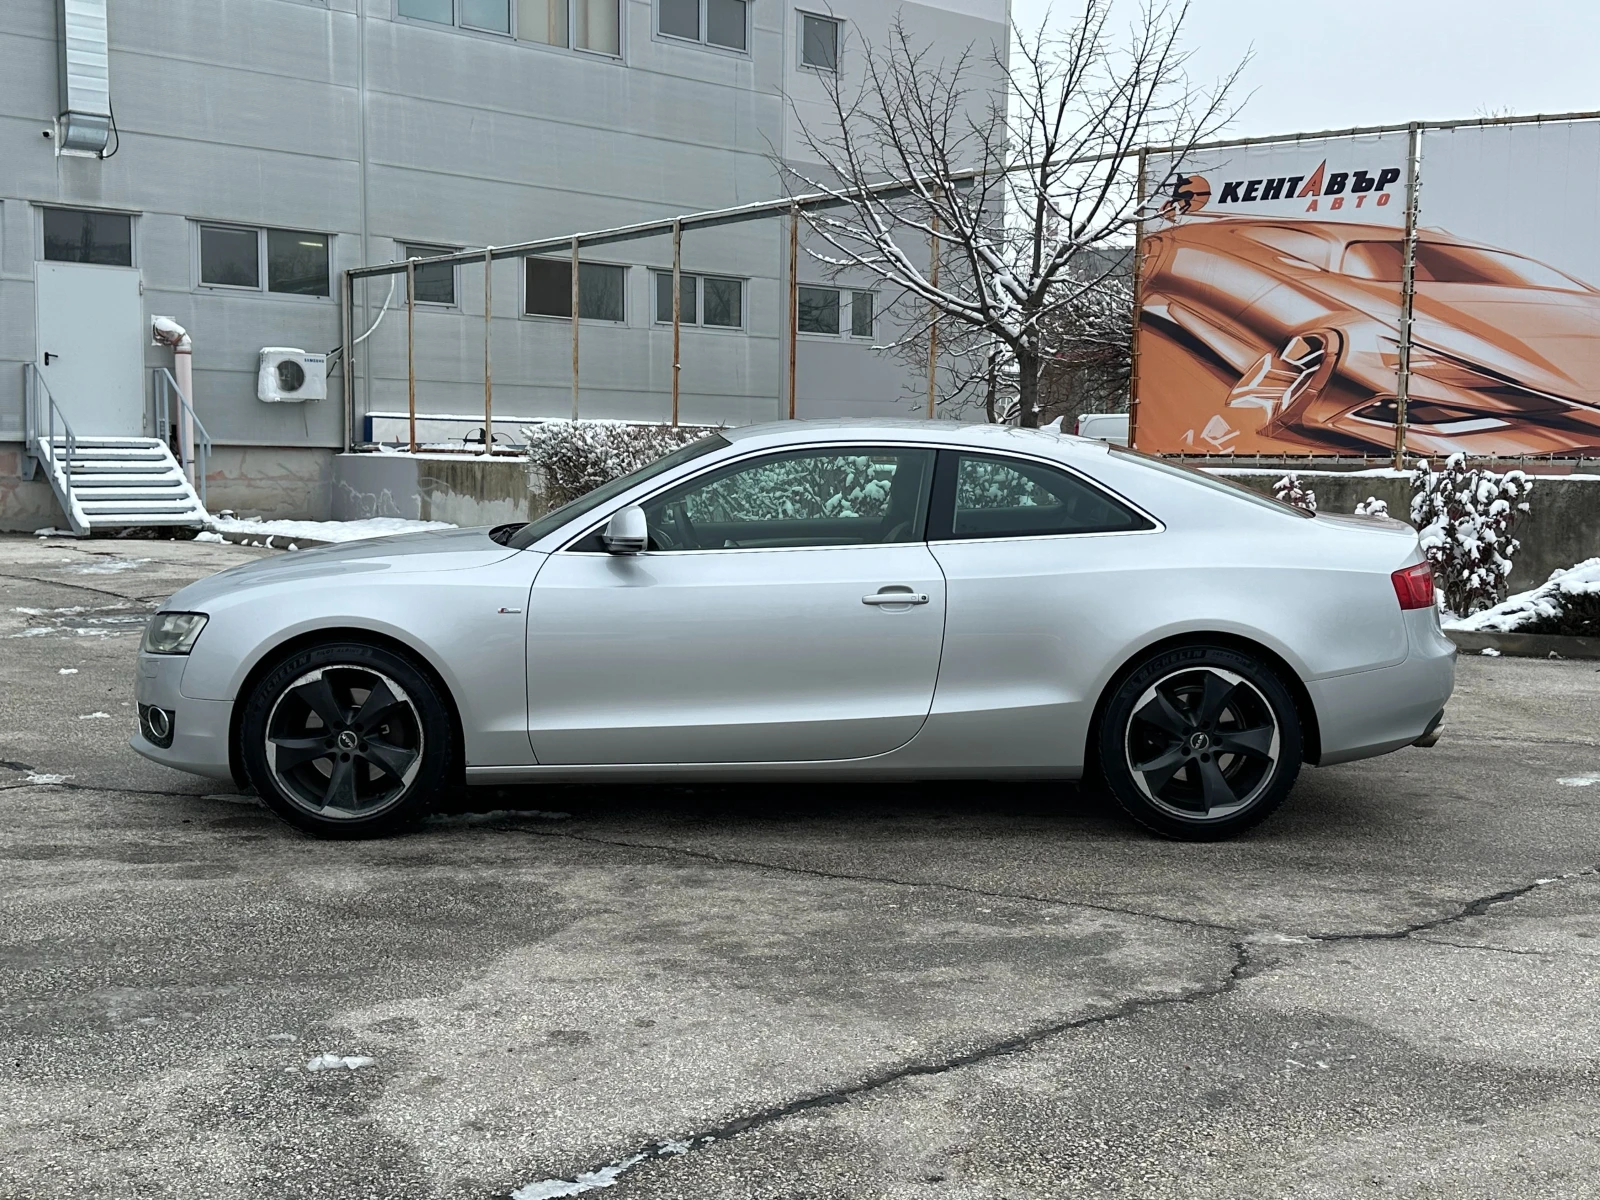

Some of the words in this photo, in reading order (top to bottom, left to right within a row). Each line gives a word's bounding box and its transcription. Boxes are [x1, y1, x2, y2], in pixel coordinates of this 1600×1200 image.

[1218, 158, 1401, 204] КЕНТАВЪР
[1305, 193, 1391, 212] АВТО
[257, 654, 308, 707] MICHELIN
[1139, 650, 1203, 683] MICHELIN
